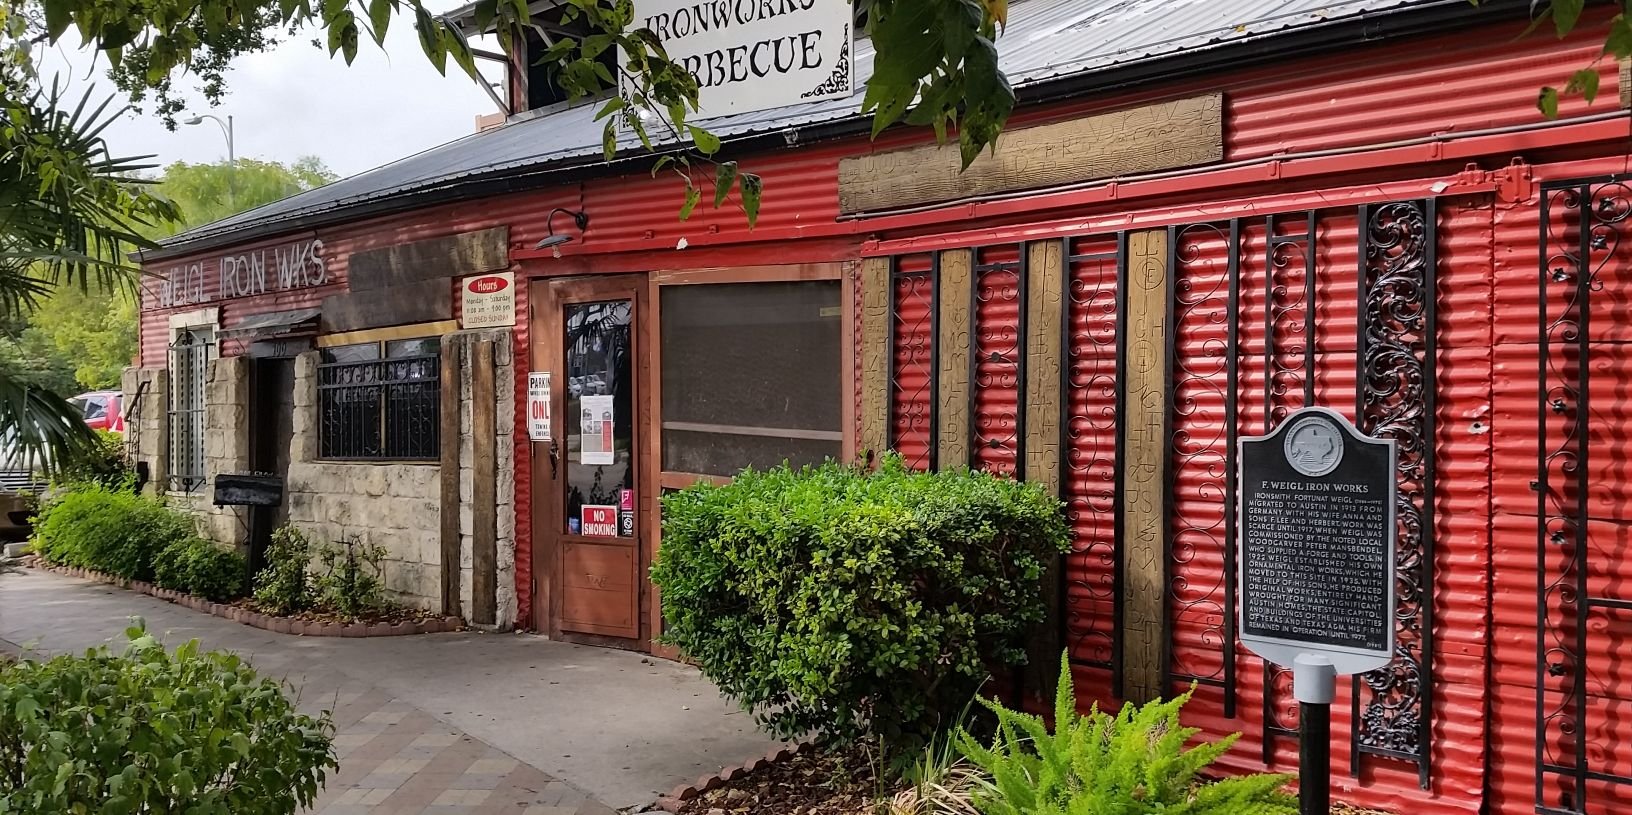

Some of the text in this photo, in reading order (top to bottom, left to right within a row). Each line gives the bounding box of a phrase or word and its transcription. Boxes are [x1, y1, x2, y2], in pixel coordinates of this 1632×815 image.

[668, 29, 823, 90] RBECUE
[158, 261, 211, 308] WEIGL
[219, 250, 265, 299] IRON
[275, 239, 328, 290] WKS.
[477, 280, 498, 292] Hours
[532, 400, 550, 420] ONL
[1271, 481, 1303, 490] WEIGL
[1306, 482, 1329, 491] IRON
[1333, 483, 1368, 492] WORKS
[1248, 499, 1283, 507] MIGRATED
[1254, 492, 1290, 500] IRONSMITH
[1294, 494, 1328, 502] FORTUNAT
[594, 510, 605, 522] NO
[1248, 507, 1282, 515] GERMANY
[584, 523, 615, 536] SMOKING
[1248, 522, 1274, 530] SCARCE
[1315, 526, 1337, 534] WHEN
[1341, 528, 1364, 536] WEIGL
[1341, 520, 1363, 528] WORK
[1248, 530, 1303, 540] COMMISSIONED
[1332, 535, 1355, 544] NOTED
[1358, 537, 1382, 546] LOCAL
[1248, 537, 1302, 548] WOODCARVER
[1306, 541, 1326, 549] PETER
[1267, 546, 1296, 555] SUPPLIED
[1306, 549, 1328, 558] FORGE
[1248, 560, 1295, 570] ORNAMENTAL
[1297, 564, 1314, 572] IRON
[1345, 568, 1369, 577] WHICH
[1268, 554, 1292, 562] WEIGL
[1295, 556, 1345, 567] ESTABLISHED
[1363, 562, 1382, 570] OWN
[1248, 568, 1274, 576] MOVED
[1290, 571, 1306, 579] THIS
[1309, 573, 1324, 581] SITE
[1361, 577, 1382, 586] WITH
[1248, 582, 1285, 593] ORIGINAL
[1317, 589, 1353, 599] ENTIRELY
[1355, 593, 1381, 602] HAND-
[1263, 577, 1279, 585] HELP
[1341, 584, 1381, 594] PRODUCED
[1248, 598, 1274, 607] AUSTIN
[1308, 604, 1321, 612] THE
[1324, 606, 1344, 614] STATE
[1307, 596, 1328, 604] MANY
[1331, 598, 1381, 610] SIGNIFICANT
[1260, 614, 1282, 623] TEXAS
[1284, 617, 1300, 625] AND
[1302, 619, 1325, 628] TEXAS
[1362, 626, 1381, 634] FIRM
[1264, 607, 1302, 618] BUILDINGS
[1333, 614, 1382, 626] UNIVERSITIES
[1248, 621, 1279, 630] REMAINED
[1292, 626, 1327, 636] OPERATION
[1330, 630, 1349, 638] UNTIL
